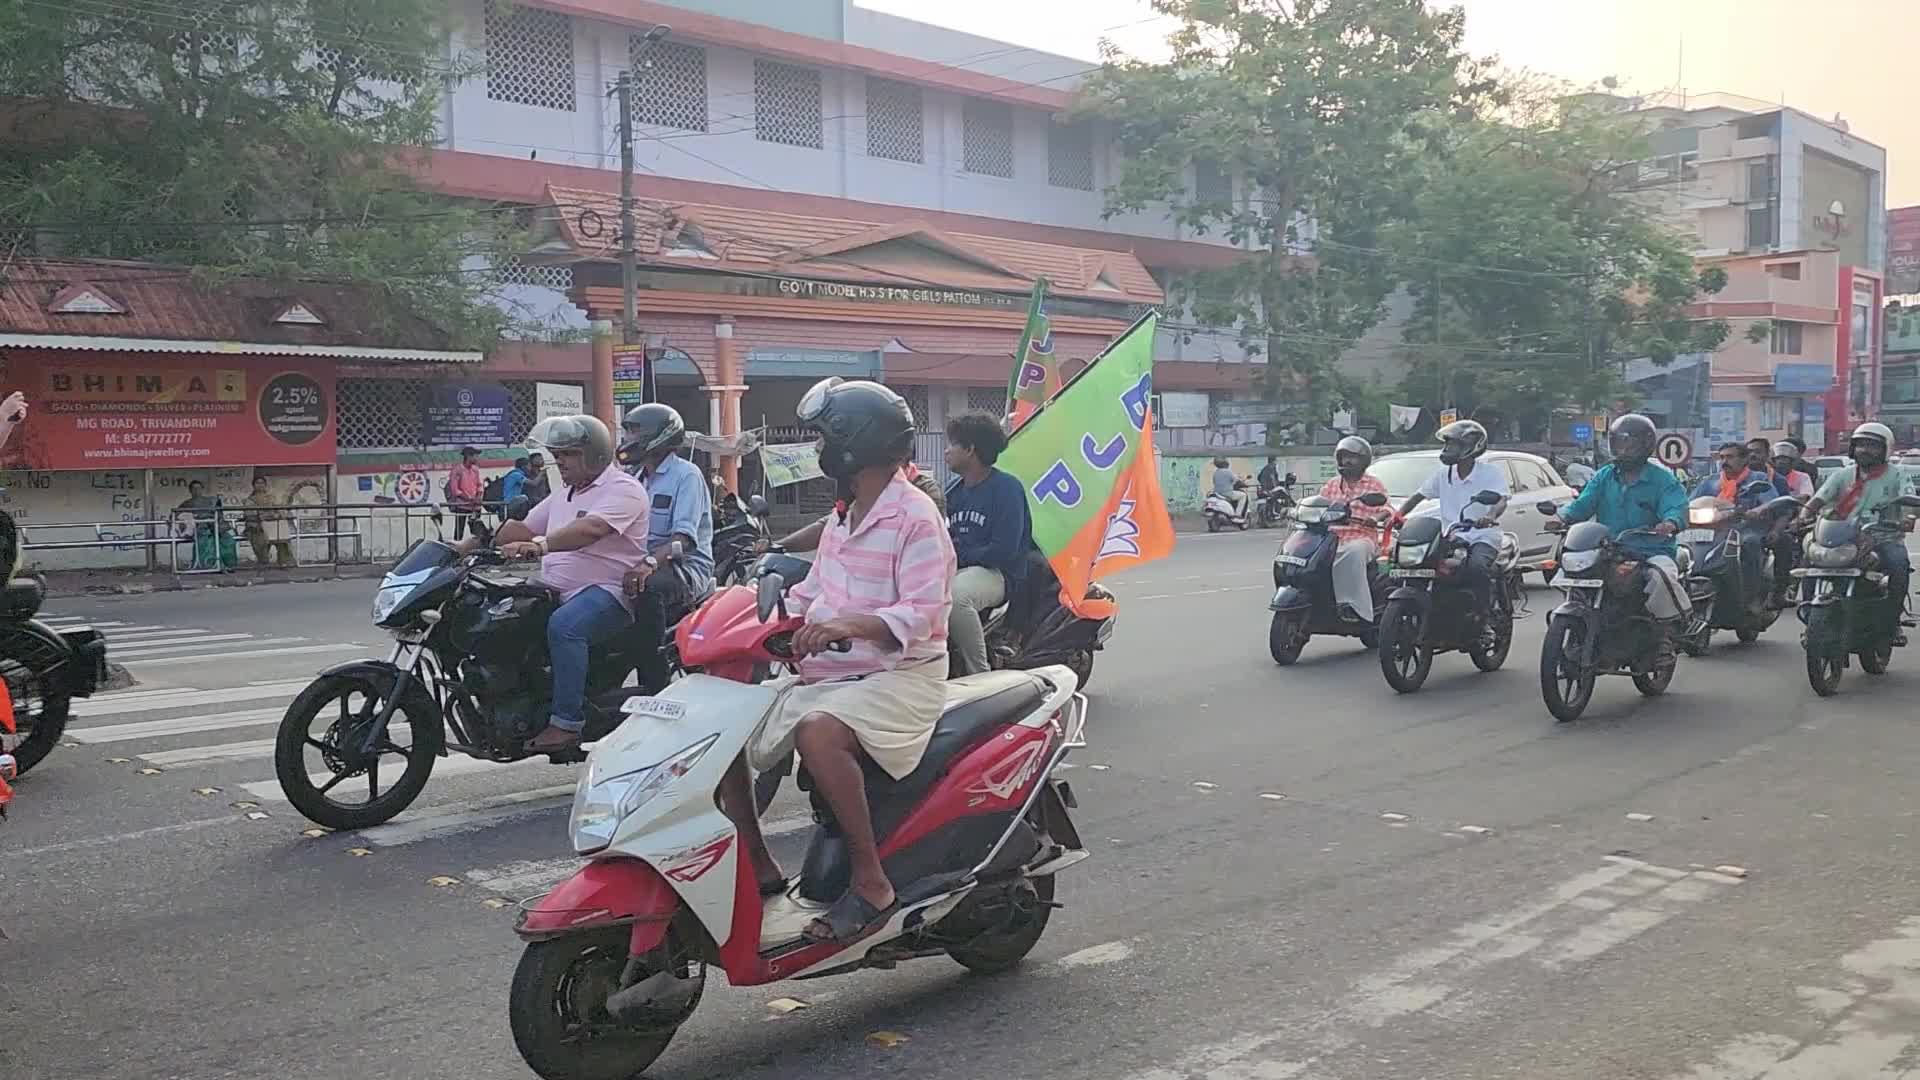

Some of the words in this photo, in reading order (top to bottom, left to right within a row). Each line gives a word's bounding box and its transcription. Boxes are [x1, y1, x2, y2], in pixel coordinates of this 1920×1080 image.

[778, 280, 814, 294] GOVT
[817, 282, 856, 298] MODEL
[887, 287, 909, 301] FOR
[912, 289, 941, 303] GIRLS
[51, 374, 208, 394] BHIMA
[272, 387, 318, 405] 2.5%
[76, 418, 98, 429] MG
[101, 418, 138, 431] ROAD,
[141, 418, 217, 429] TRIVANDRUM
[105, 433, 121, 445] M:
[1031, 370, 1154, 509] BJP
[84, 446, 211, 460] www.bhimajewellery.com
